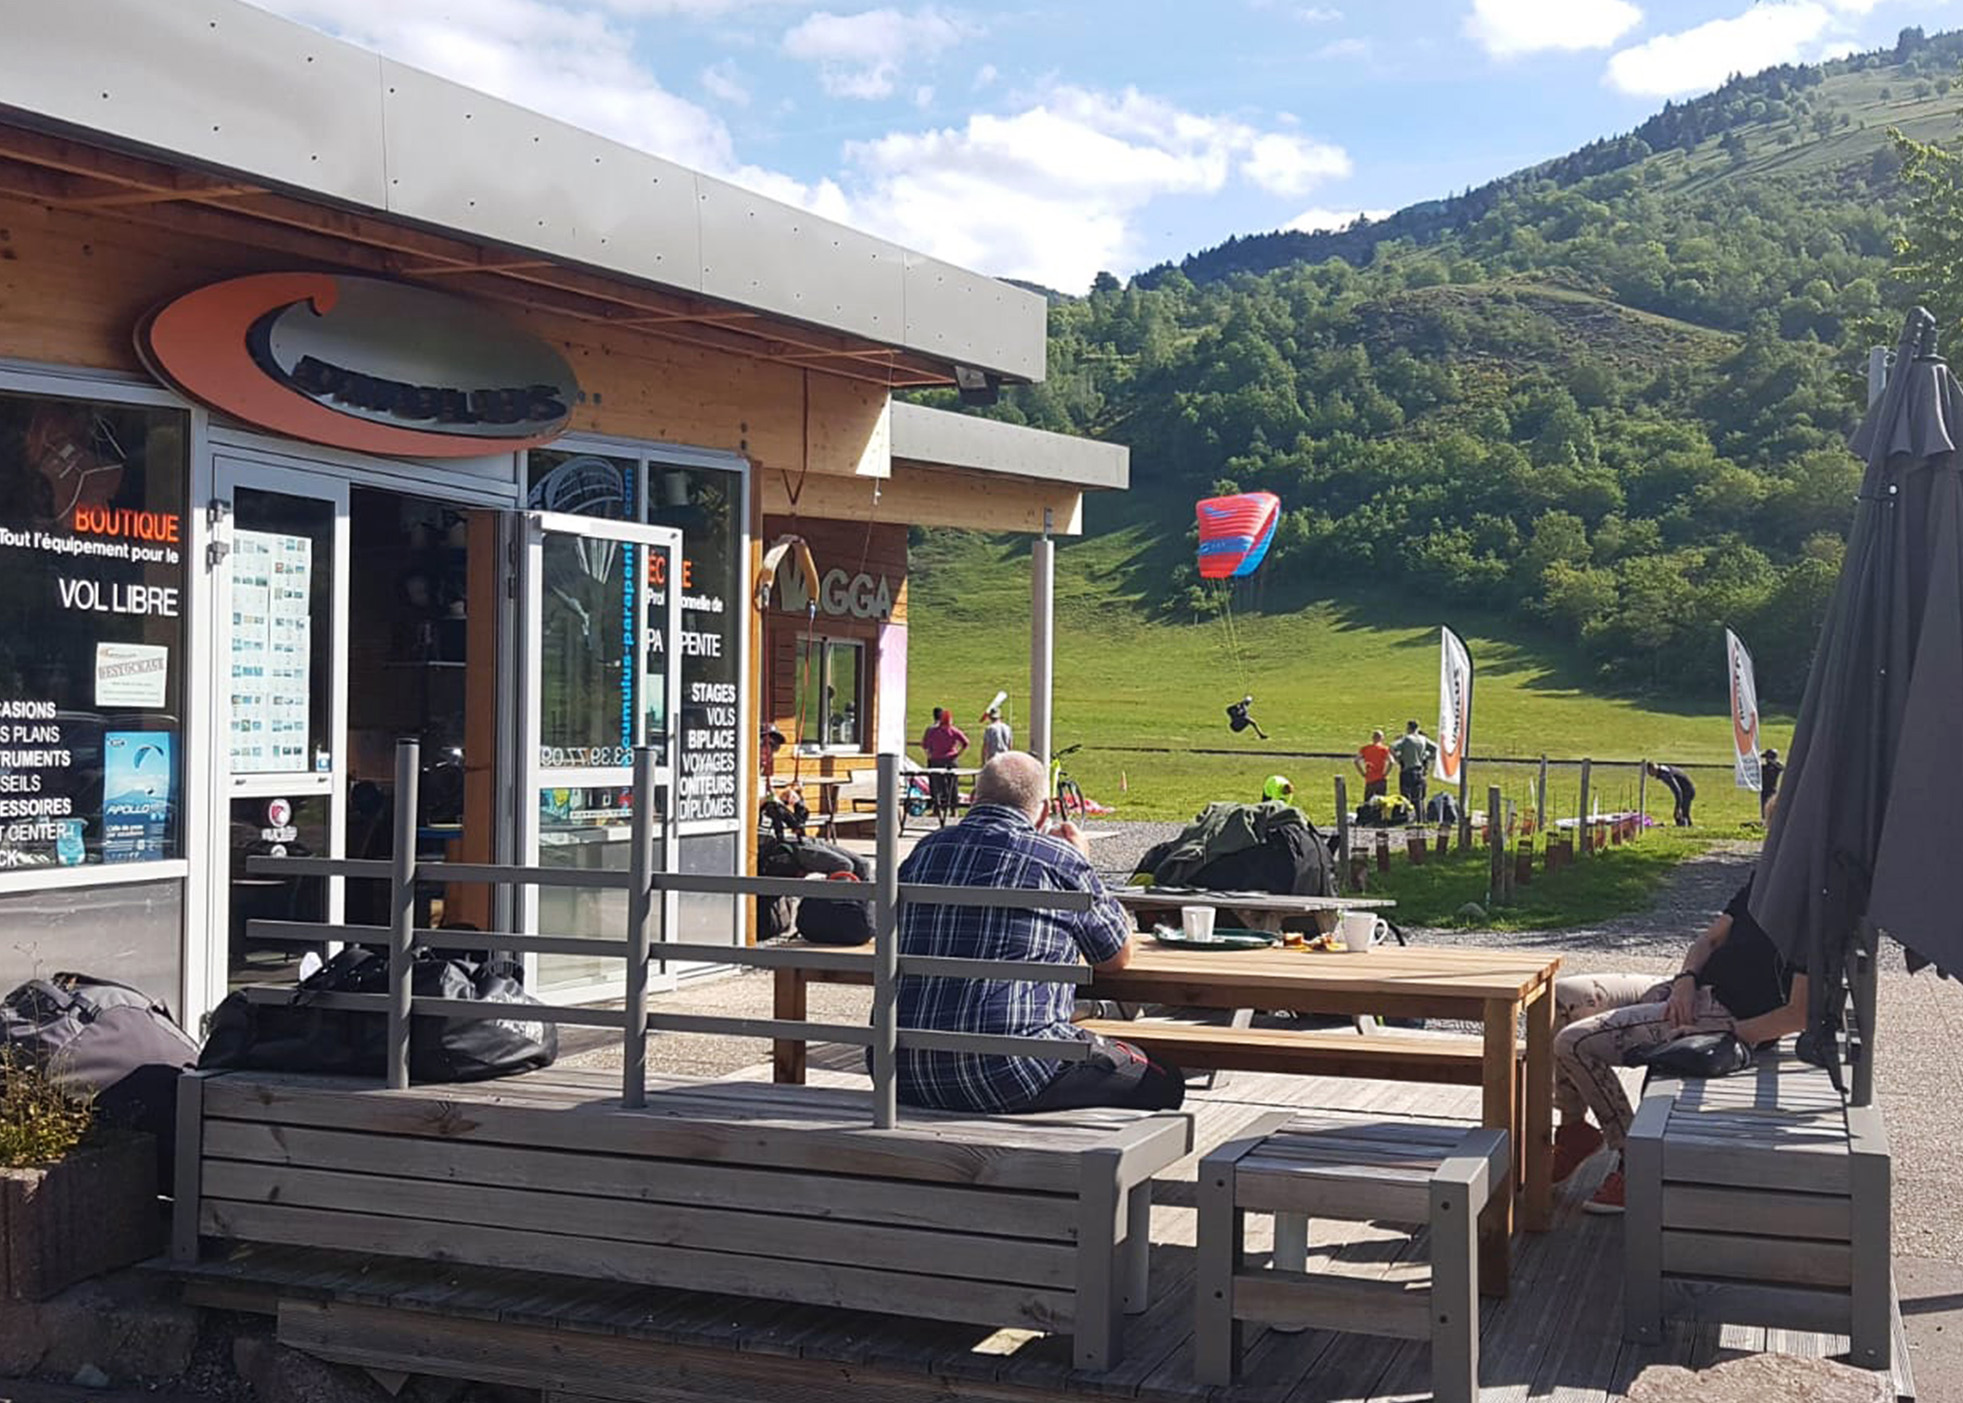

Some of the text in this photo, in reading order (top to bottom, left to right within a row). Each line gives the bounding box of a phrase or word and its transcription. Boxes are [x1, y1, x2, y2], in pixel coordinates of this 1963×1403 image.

[75, 506, 179, 542] BOUTIQUE
[0, 527, 179, 564] Tout l'équipement pour le
[59, 577, 179, 616] VOL LIBRE
[691, 682, 736, 703] STAGES
[0, 701, 56, 719] ASIONS
[706, 707, 736, 726] VOLS
[13, 725, 60, 743] PLANS
[688, 729, 736, 749] BIPLACE
[682, 752, 735, 772] VOYAGES
[0, 774, 41, 793] SEILS
[679, 775, 735, 796] ONITEURS
[0, 797, 72, 817] ESSOIRES
[106, 803, 150, 815] APOLLO
[0, 848, 18, 868] CK
